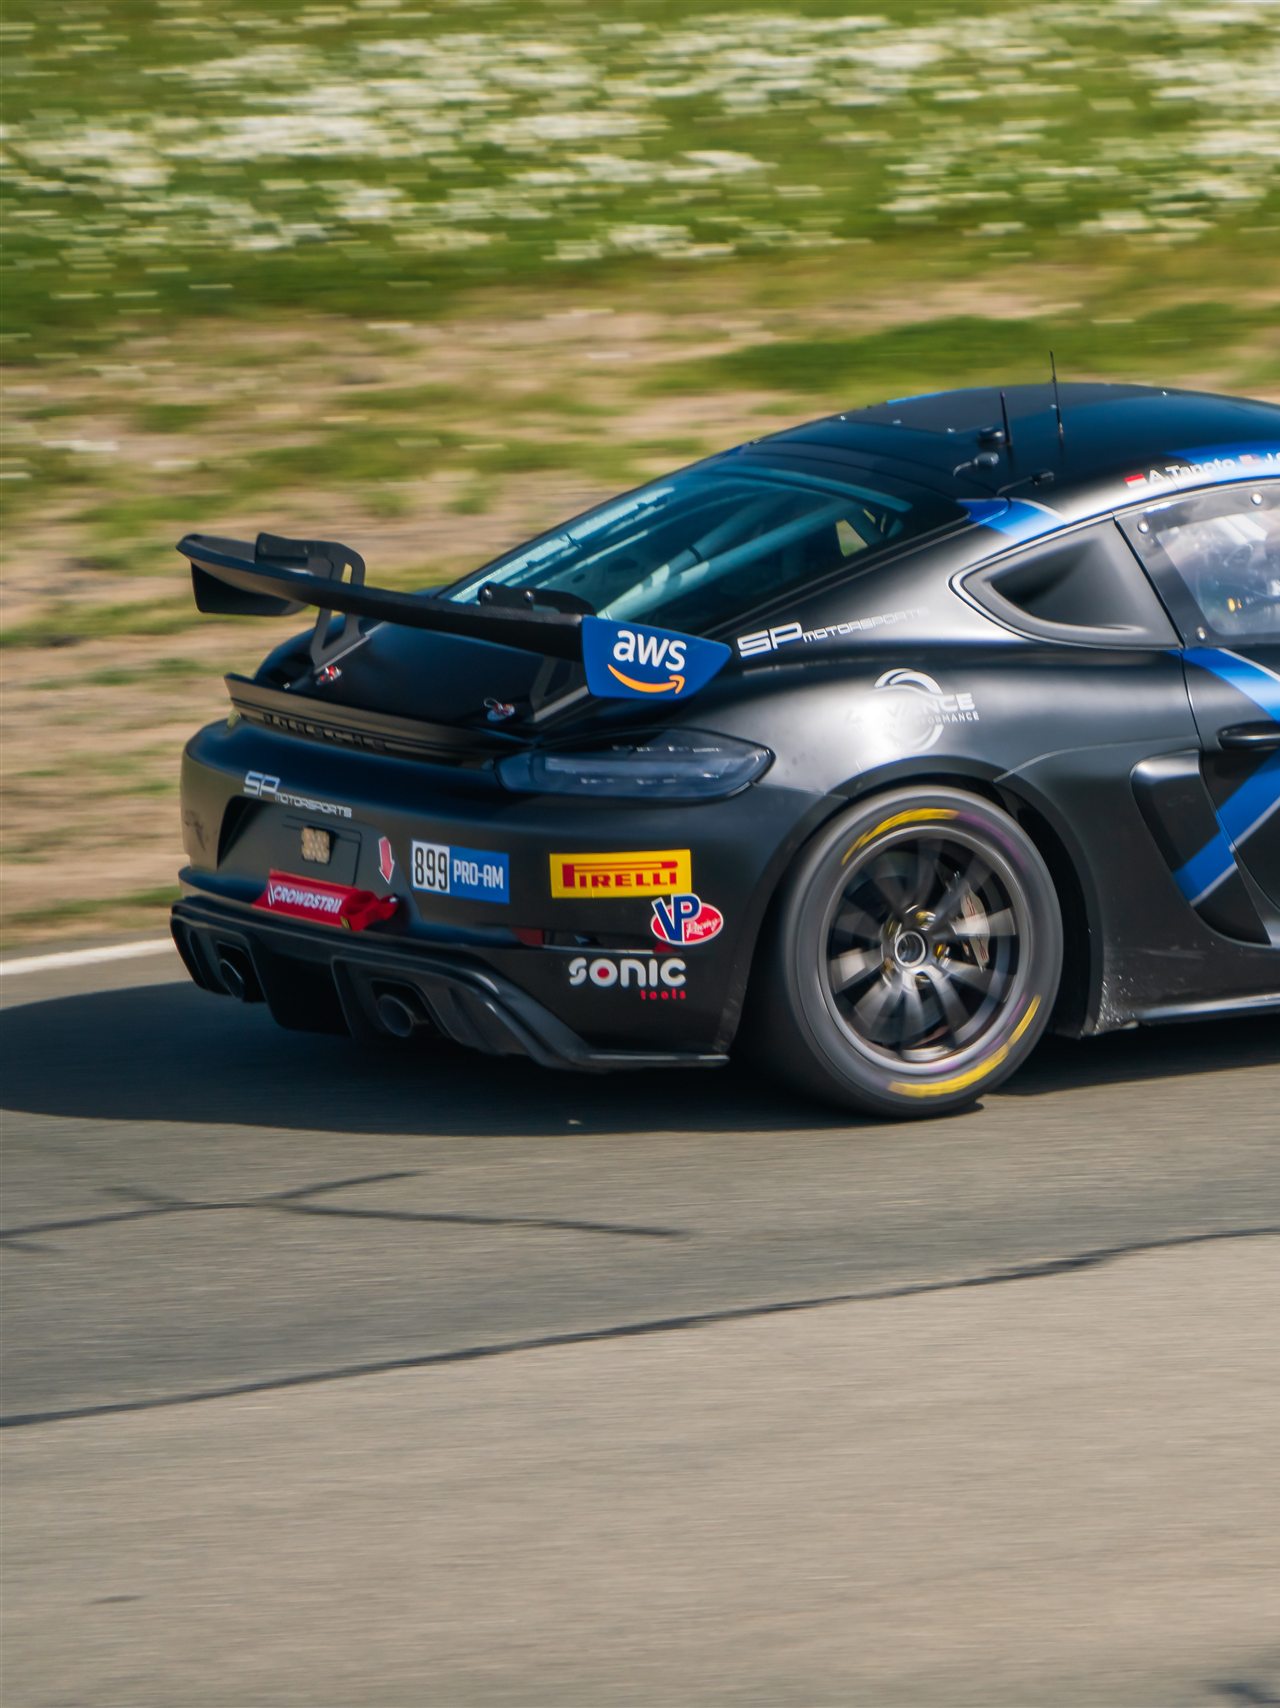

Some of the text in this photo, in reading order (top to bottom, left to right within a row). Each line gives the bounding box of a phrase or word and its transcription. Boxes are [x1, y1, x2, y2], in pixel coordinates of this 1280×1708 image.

[613, 630, 687, 672] aws
[737, 607, 929, 659] SP MOTORSPORTS
[243, 771, 352, 818] SP MOTORSPORTS
[414, 846, 504, 891] 899 PRO-AM
[562, 860, 678, 889] PIRELLI
[652, 893, 701, 944] VP
[640, 987, 687, 1000] tools
